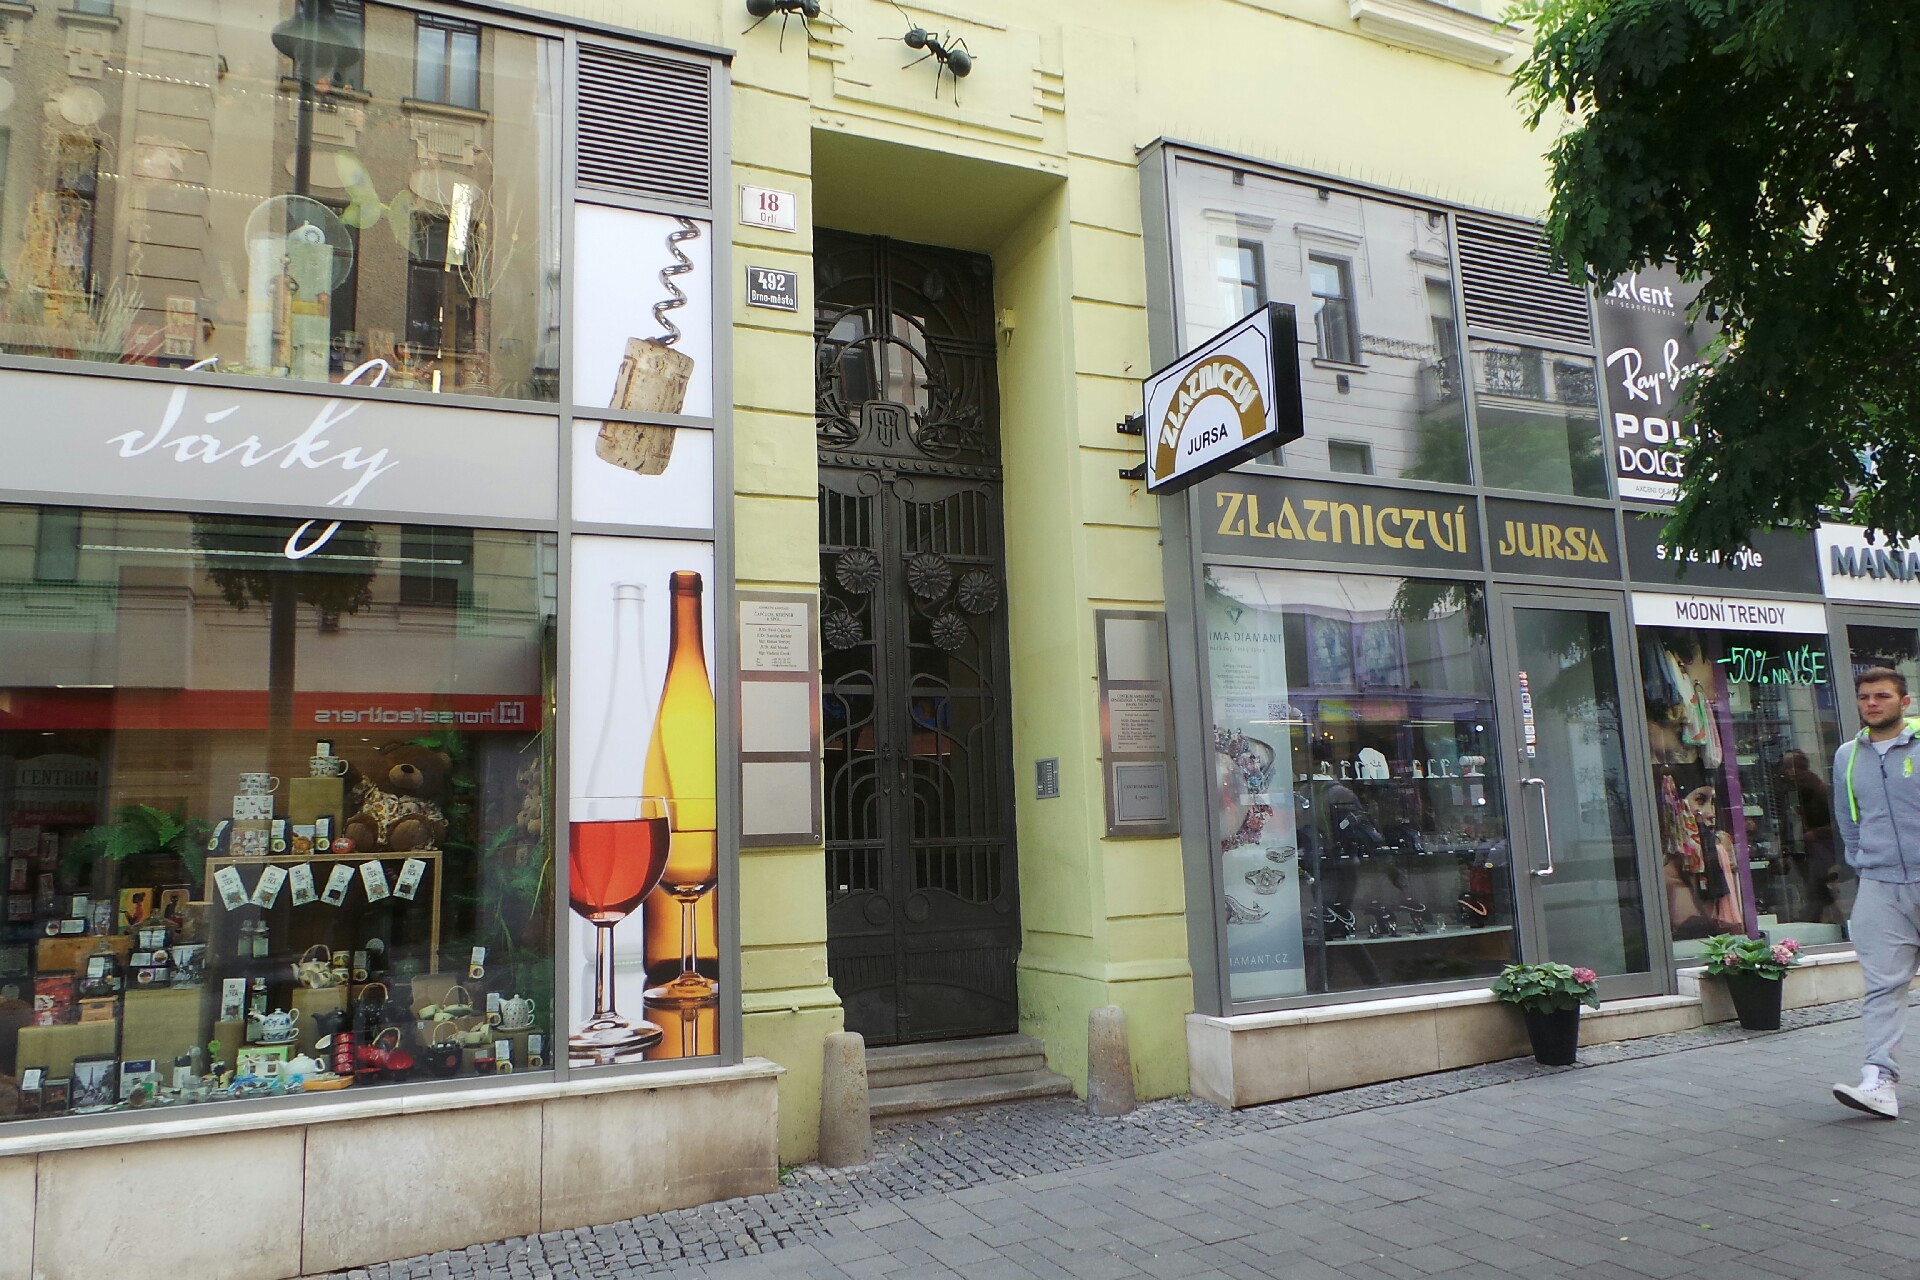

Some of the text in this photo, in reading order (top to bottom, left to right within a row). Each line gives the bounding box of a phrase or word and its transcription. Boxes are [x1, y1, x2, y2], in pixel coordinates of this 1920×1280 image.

[759, 191, 779, 212] 18
[758, 271, 785, 291] 492
[1187, 422, 1228, 456] JURSA
[1216, 491, 1467, 553] ZLATNICTVÍ
[1499, 520, 1608, 563] JURSA
[1676, 596, 1785, 625] MÓDNÍ TRENDY
[1234, 632, 1281, 643] DIAMANT
[1772, 668, 1791, 684] NA
[1787, 644, 1827, 685] VŠE
[22, 768, 99, 786] CENTRUM
